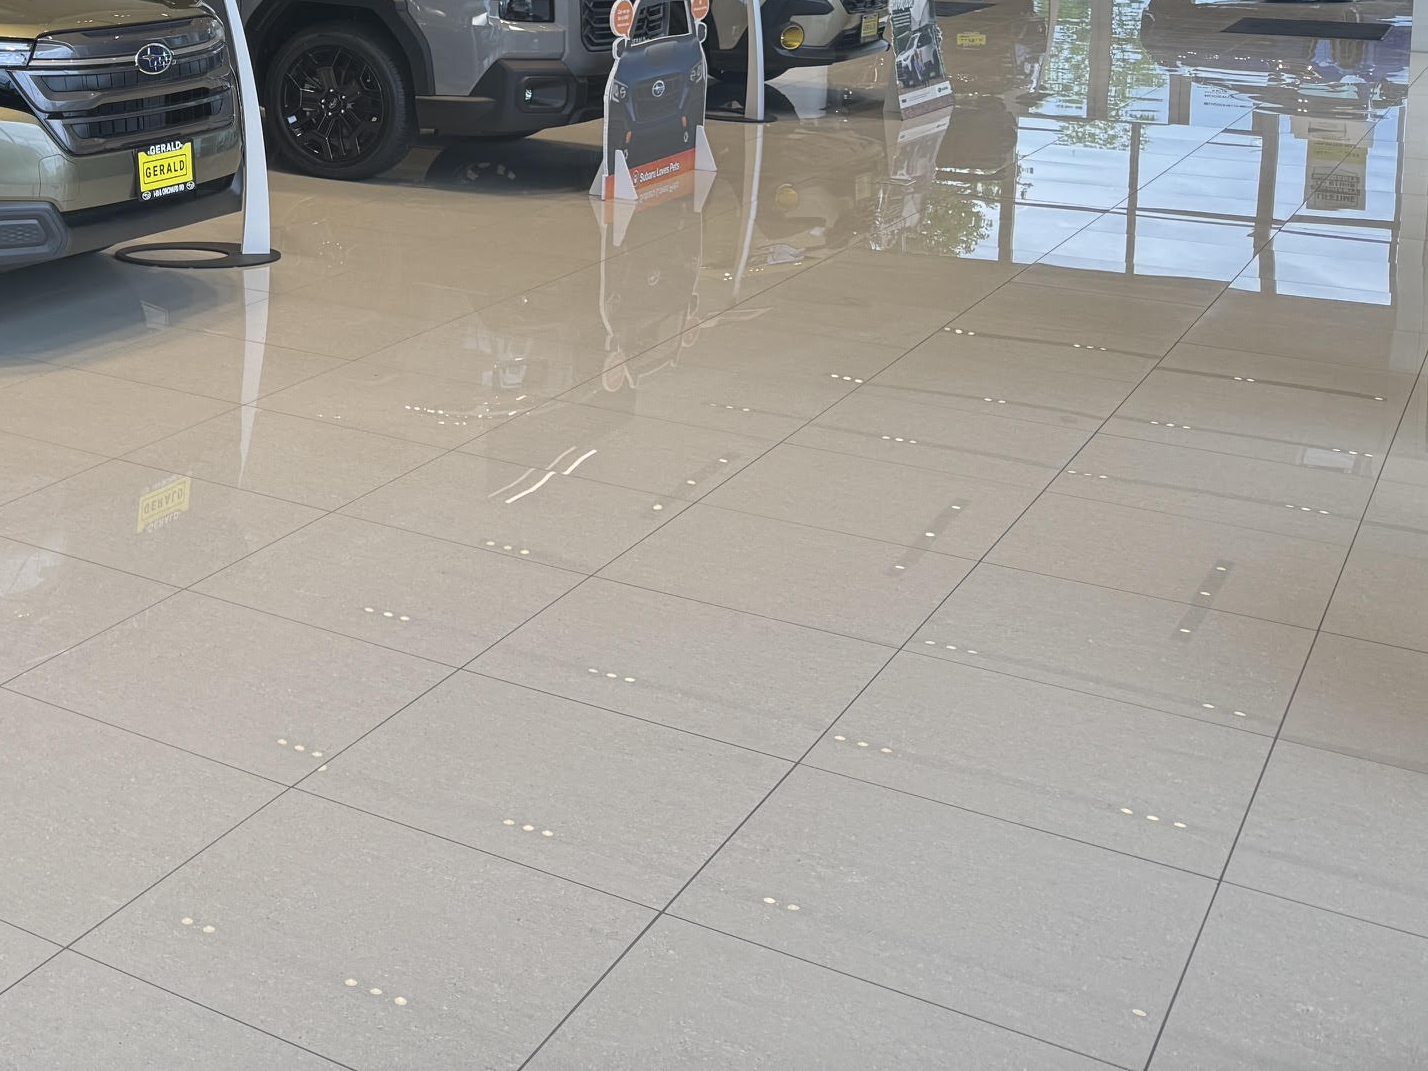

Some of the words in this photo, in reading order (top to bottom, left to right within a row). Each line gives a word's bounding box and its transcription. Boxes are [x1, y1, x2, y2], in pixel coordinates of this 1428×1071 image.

[149, 141, 182, 155] GERALD
[145, 160, 185, 178] GERALD
[656, 166, 670, 177] Loves
